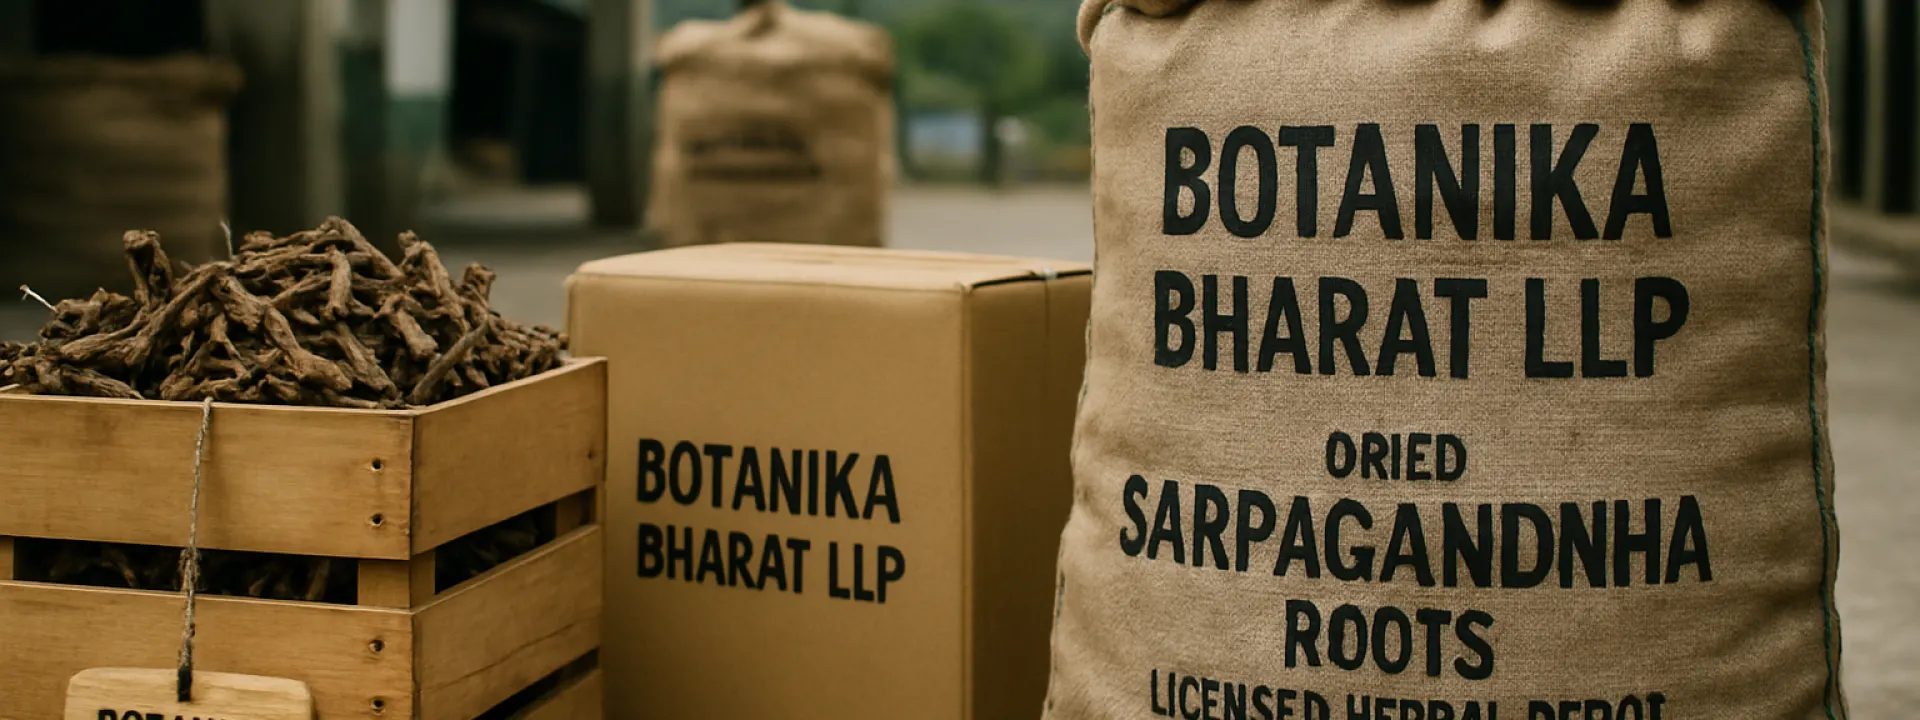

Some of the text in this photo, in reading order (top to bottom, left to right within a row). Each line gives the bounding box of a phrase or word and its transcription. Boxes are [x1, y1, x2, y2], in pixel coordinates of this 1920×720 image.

[1162, 123, 1672, 242] BOTANIKA
[1154, 270, 1690, 380] BHARAT LLP
[636, 438, 901, 524] BOTANIKA
[1326, 431, 1467, 484] ORIED
[636, 523, 906, 604] BHARAT LLP
[1120, 474, 1713, 589] SARPAGANDNHA
[1285, 599, 1495, 680] ROOTS
[1151, 669, 1331, 720] LICENSED
